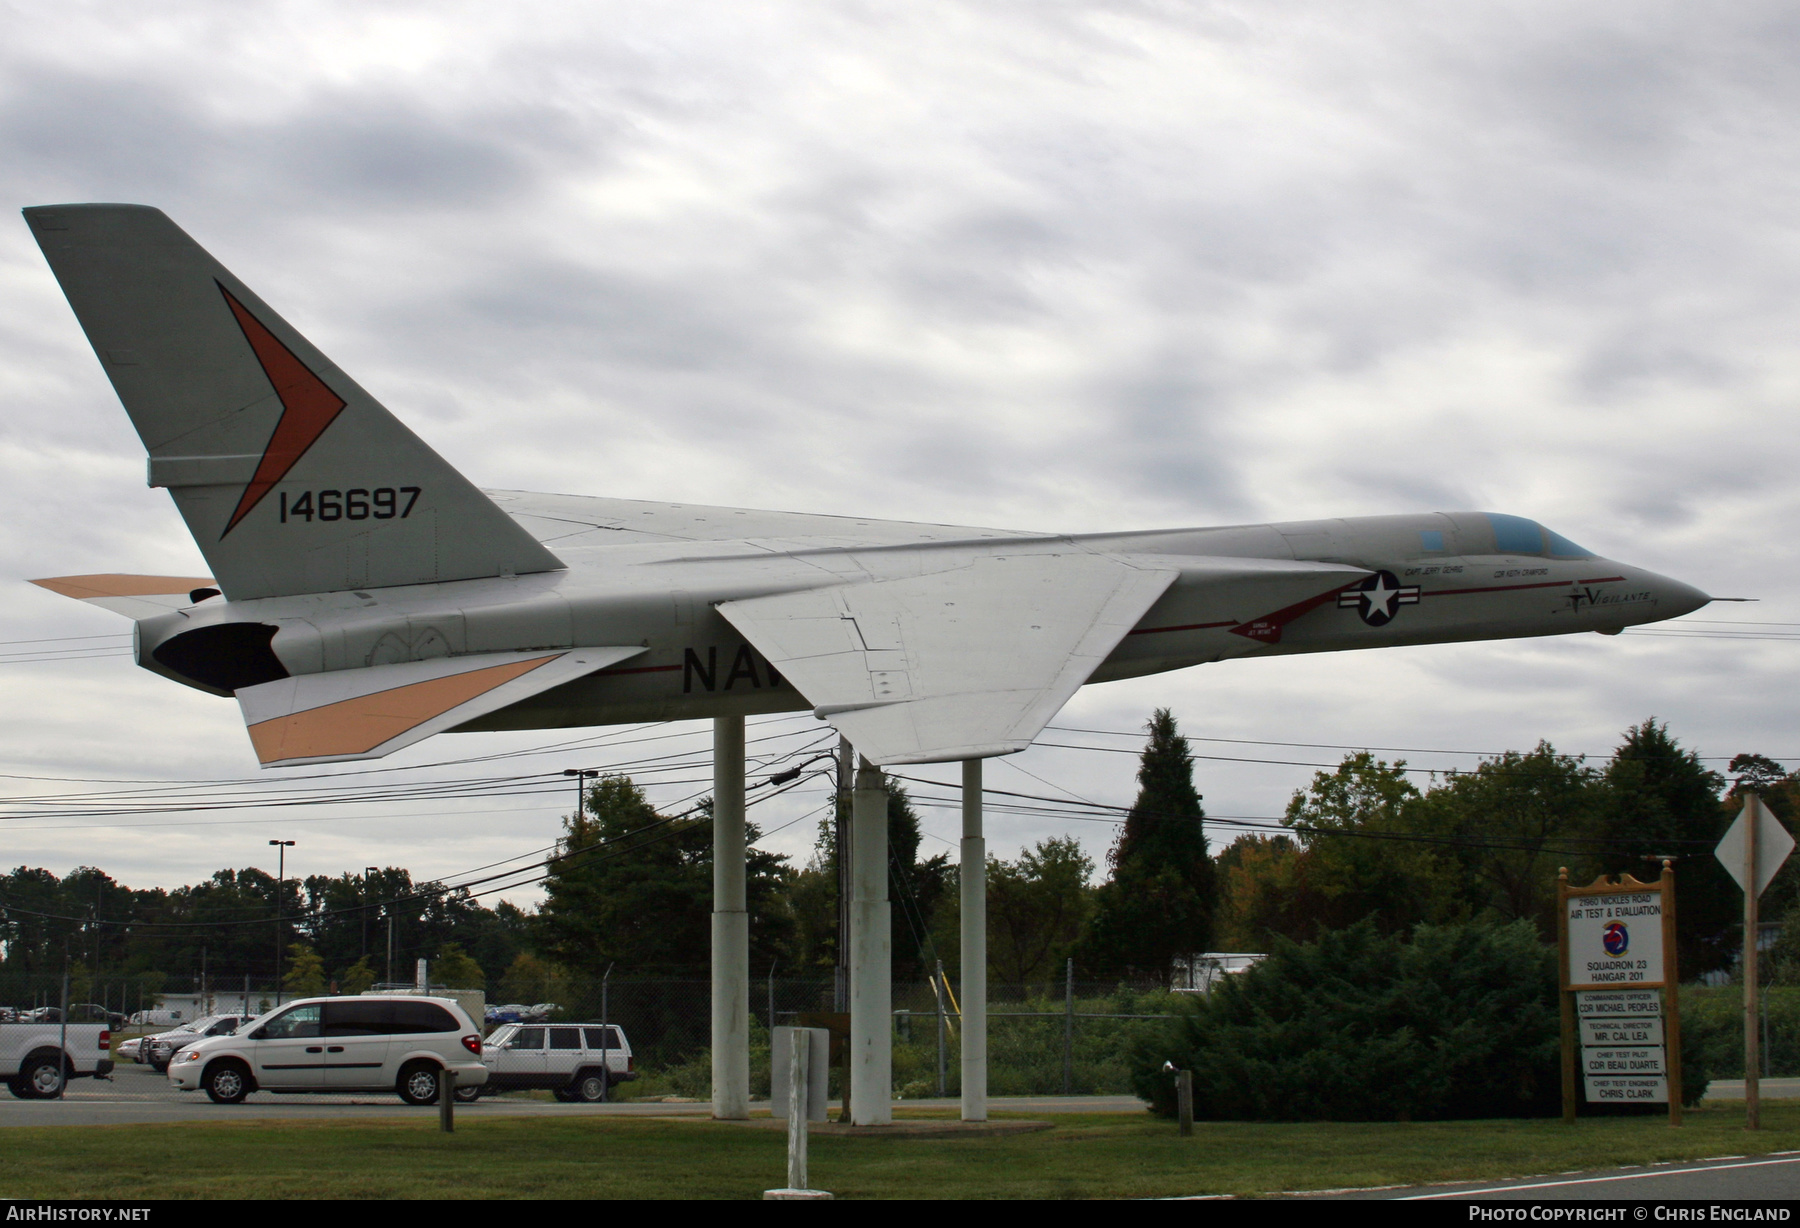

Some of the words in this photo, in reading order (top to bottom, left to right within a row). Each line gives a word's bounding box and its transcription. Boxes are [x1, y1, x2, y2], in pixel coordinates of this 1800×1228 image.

[280, 486, 422, 523] 146697
[1601, 896, 1630, 905] NICKLES
[1632, 894, 1651, 903] ROAD
[1570, 909, 1582, 919] AIR
[1585, 908, 1604, 918] TEST
[1607, 907, 1612, 917] &
[1615, 905, 1660, 916] EVALUATION
[1587, 961, 1633, 971] SQUADRON
[1637, 960, 1647, 969] 23
[1591, 973, 1625, 981] HANGAR
[1629, 972, 1643, 981] 201
[1580, 1004, 1593, 1013] CDR
[1596, 1003, 1625, 1012] MICHAEL
[1628, 1003, 1658, 1012] PEOPLES
[1595, 1032, 1609, 1041] MR.
[1613, 1032, 1629, 1040] CAL
[1632, 1032, 1648, 1040] LEA
[1589, 1061, 1605, 1070] CDR
[1608, 1061, 1627, 1070] BEAU
[1630, 1061, 1659, 1069] DUARTE
[1600, 1090, 1623, 1098] CHRIS
[1627, 1089, 1654, 1098] CLARK
